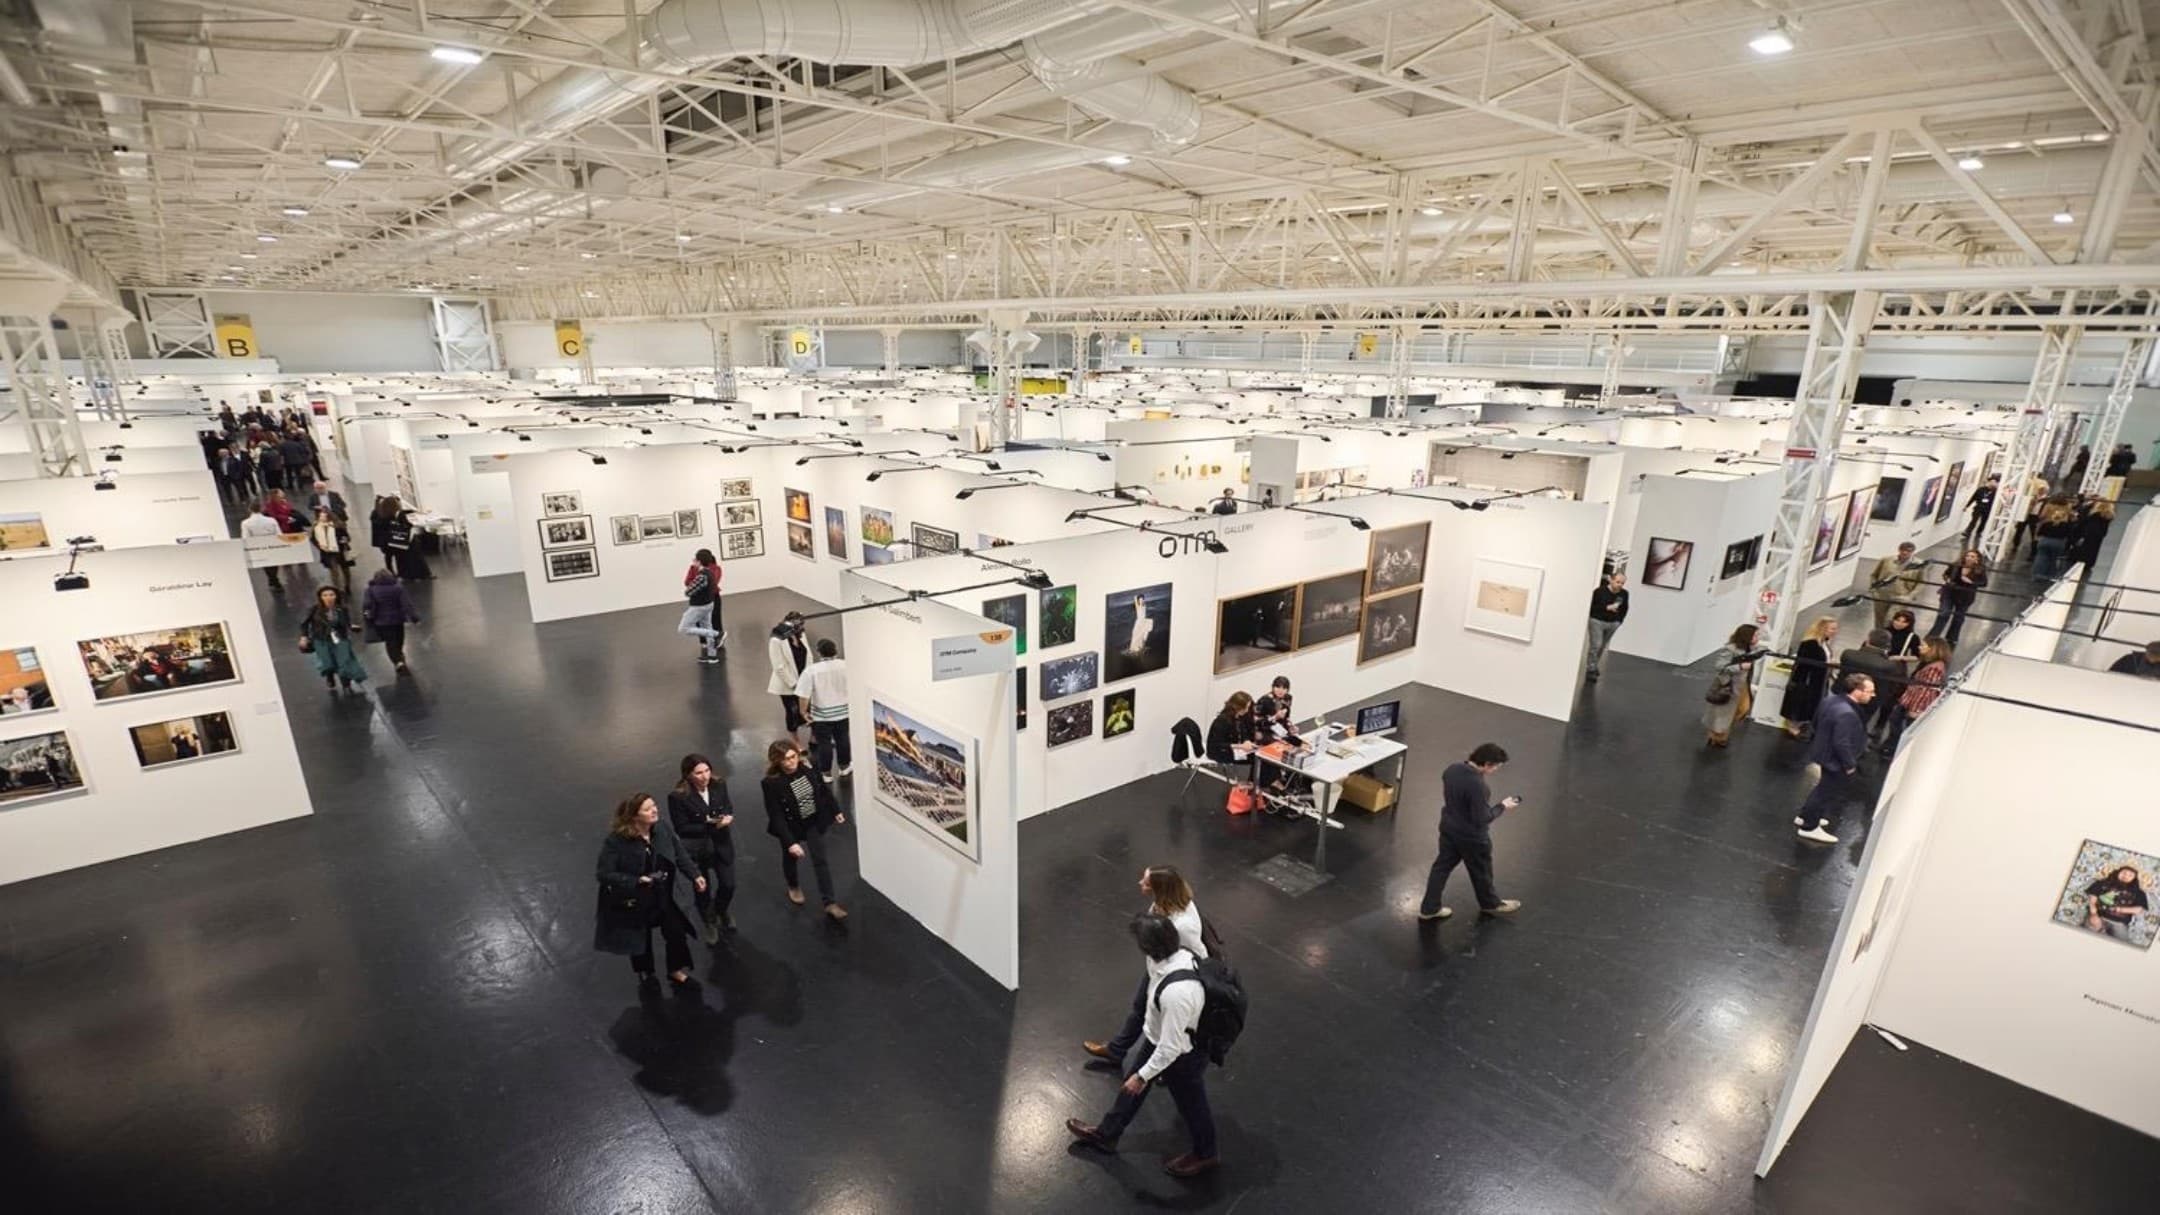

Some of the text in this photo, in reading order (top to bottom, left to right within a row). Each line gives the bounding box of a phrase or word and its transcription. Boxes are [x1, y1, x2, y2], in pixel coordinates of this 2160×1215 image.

[227, 338, 250, 357] B
[562, 339, 579, 357] C
[795, 341, 807, 354] D
